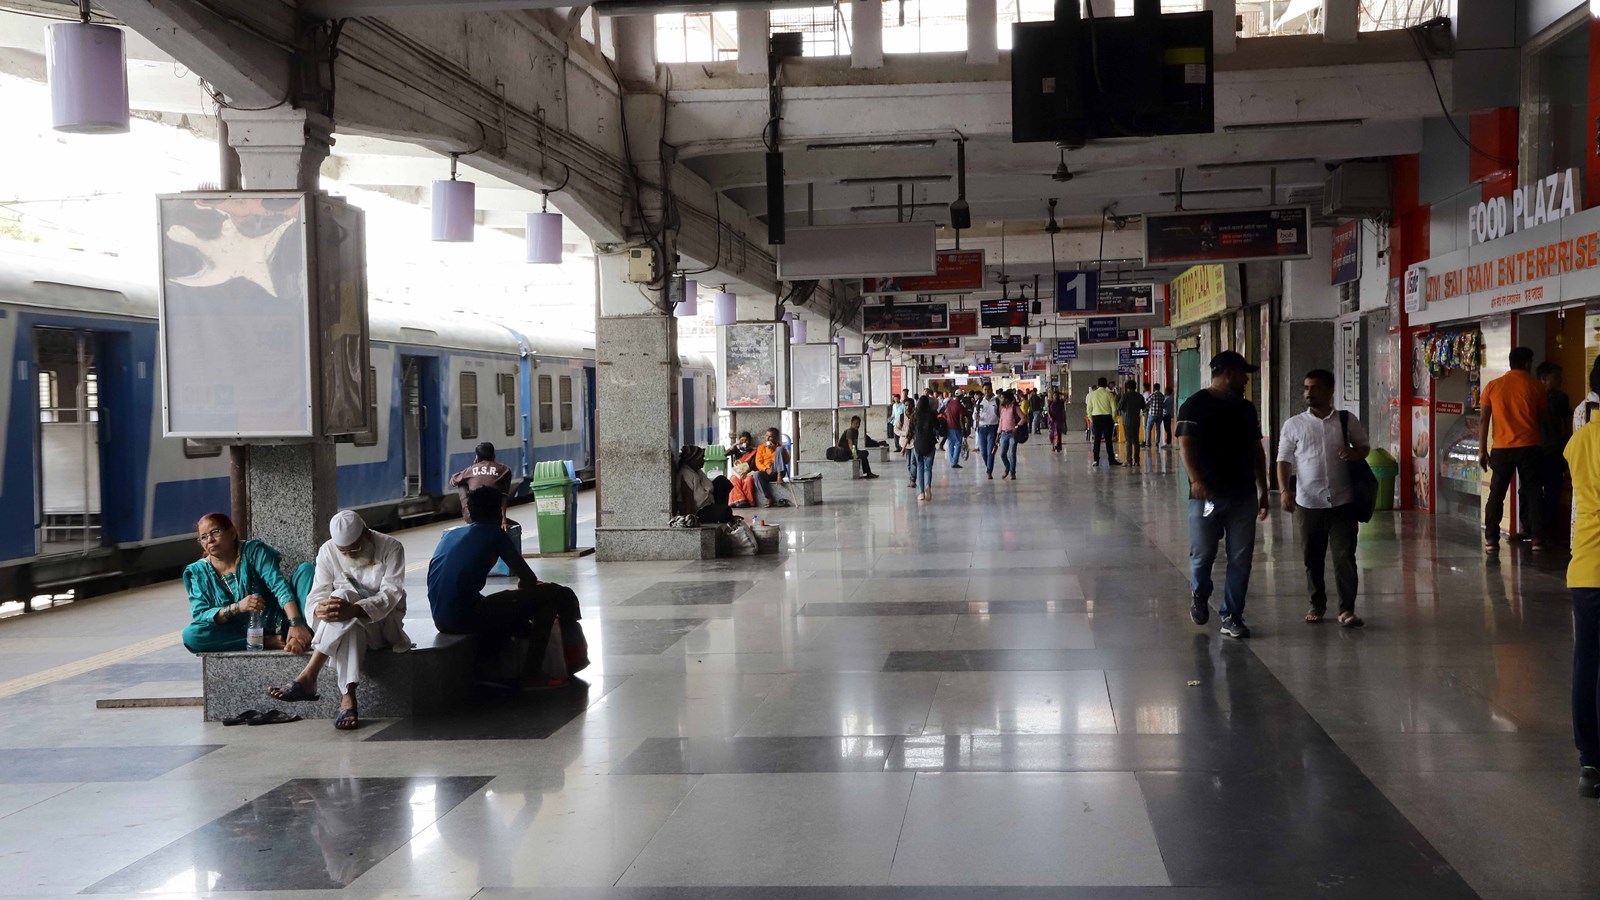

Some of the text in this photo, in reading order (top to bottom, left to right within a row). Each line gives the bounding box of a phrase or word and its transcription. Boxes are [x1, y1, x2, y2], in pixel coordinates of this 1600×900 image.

[1469, 168, 1575, 247] FOOD PLAZA
[1066, 272, 1087, 311] 1
[1182, 272, 1195, 307] FOOD
[1194, 265, 1211, 299] PLAZA
[1425, 275, 1441, 302] OM
[1444, 271, 1463, 299] SAI
[1467, 261, 1494, 293] RAM
